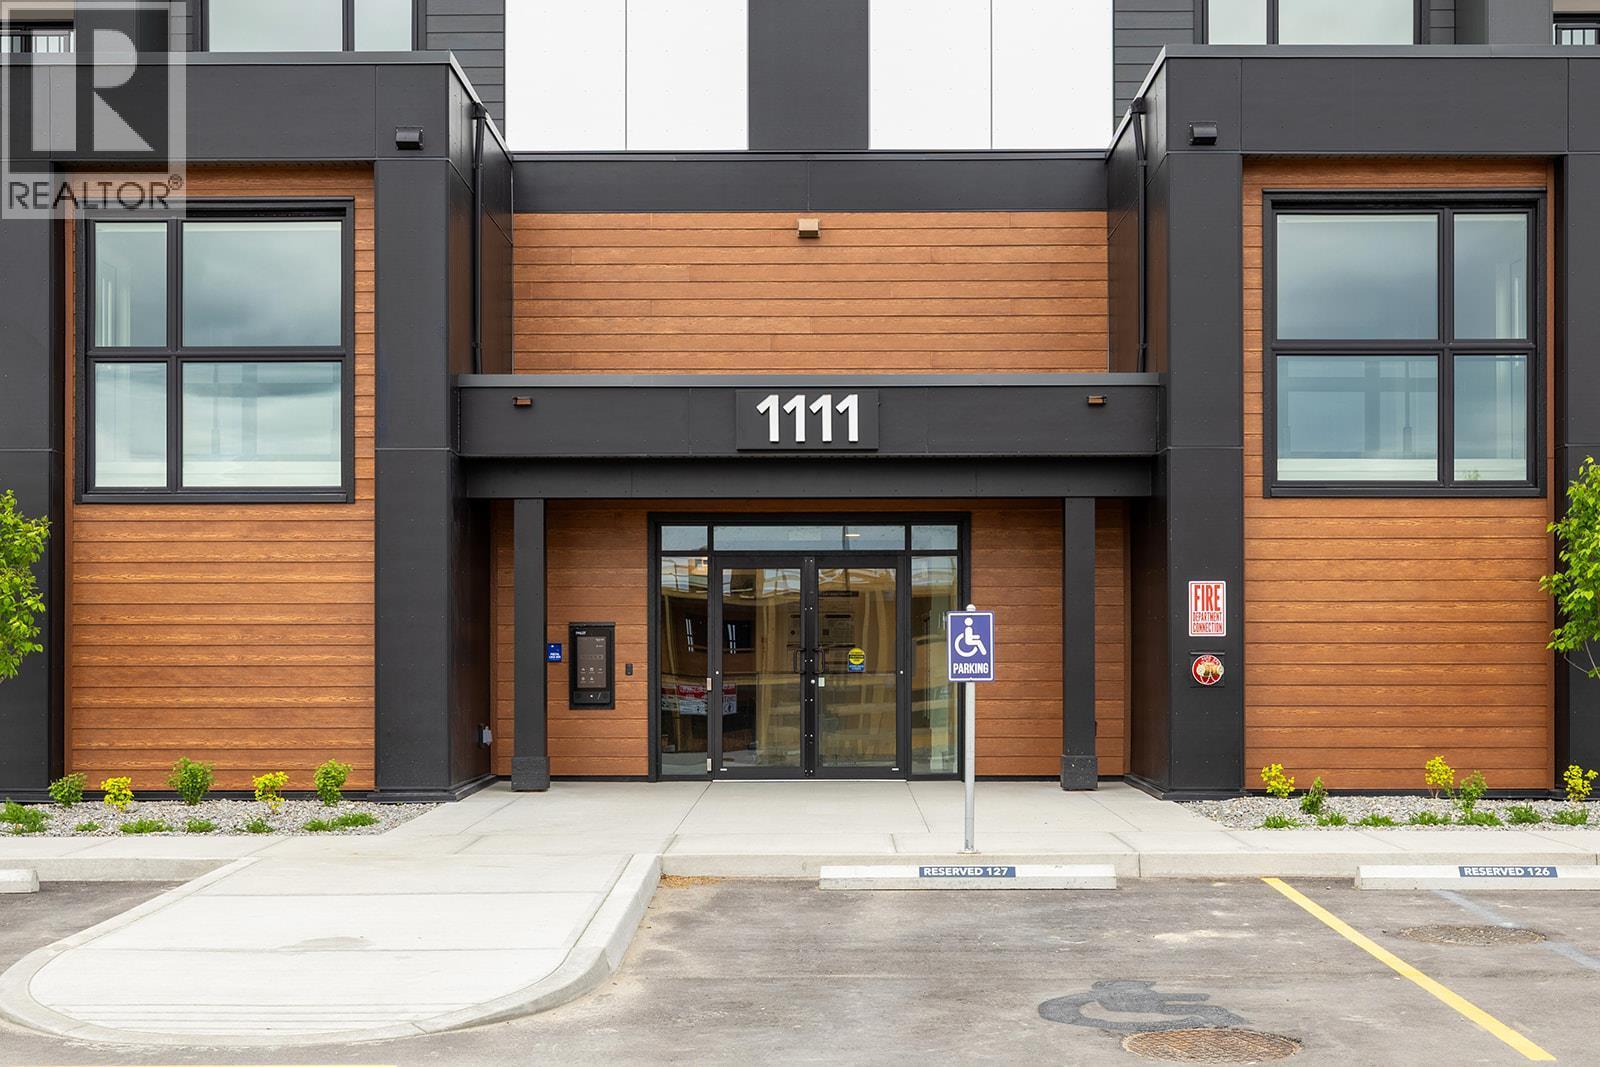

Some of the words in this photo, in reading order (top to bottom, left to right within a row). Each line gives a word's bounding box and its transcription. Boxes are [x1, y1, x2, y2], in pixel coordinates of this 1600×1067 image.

[756, 394, 859, 443] 1111
[1194, 584, 1221, 612] FIRE
[1193, 612, 1222, 622] DEPARTMENT
[1193, 622, 1222, 633] CONNECTION
[953, 662, 989, 674] PARKING
[923, 867, 984, 876] RESERVED
[986, 867, 1009, 876] 127
[1463, 867, 1525, 876] RESERVED
[1527, 867, 1551, 876] 126
